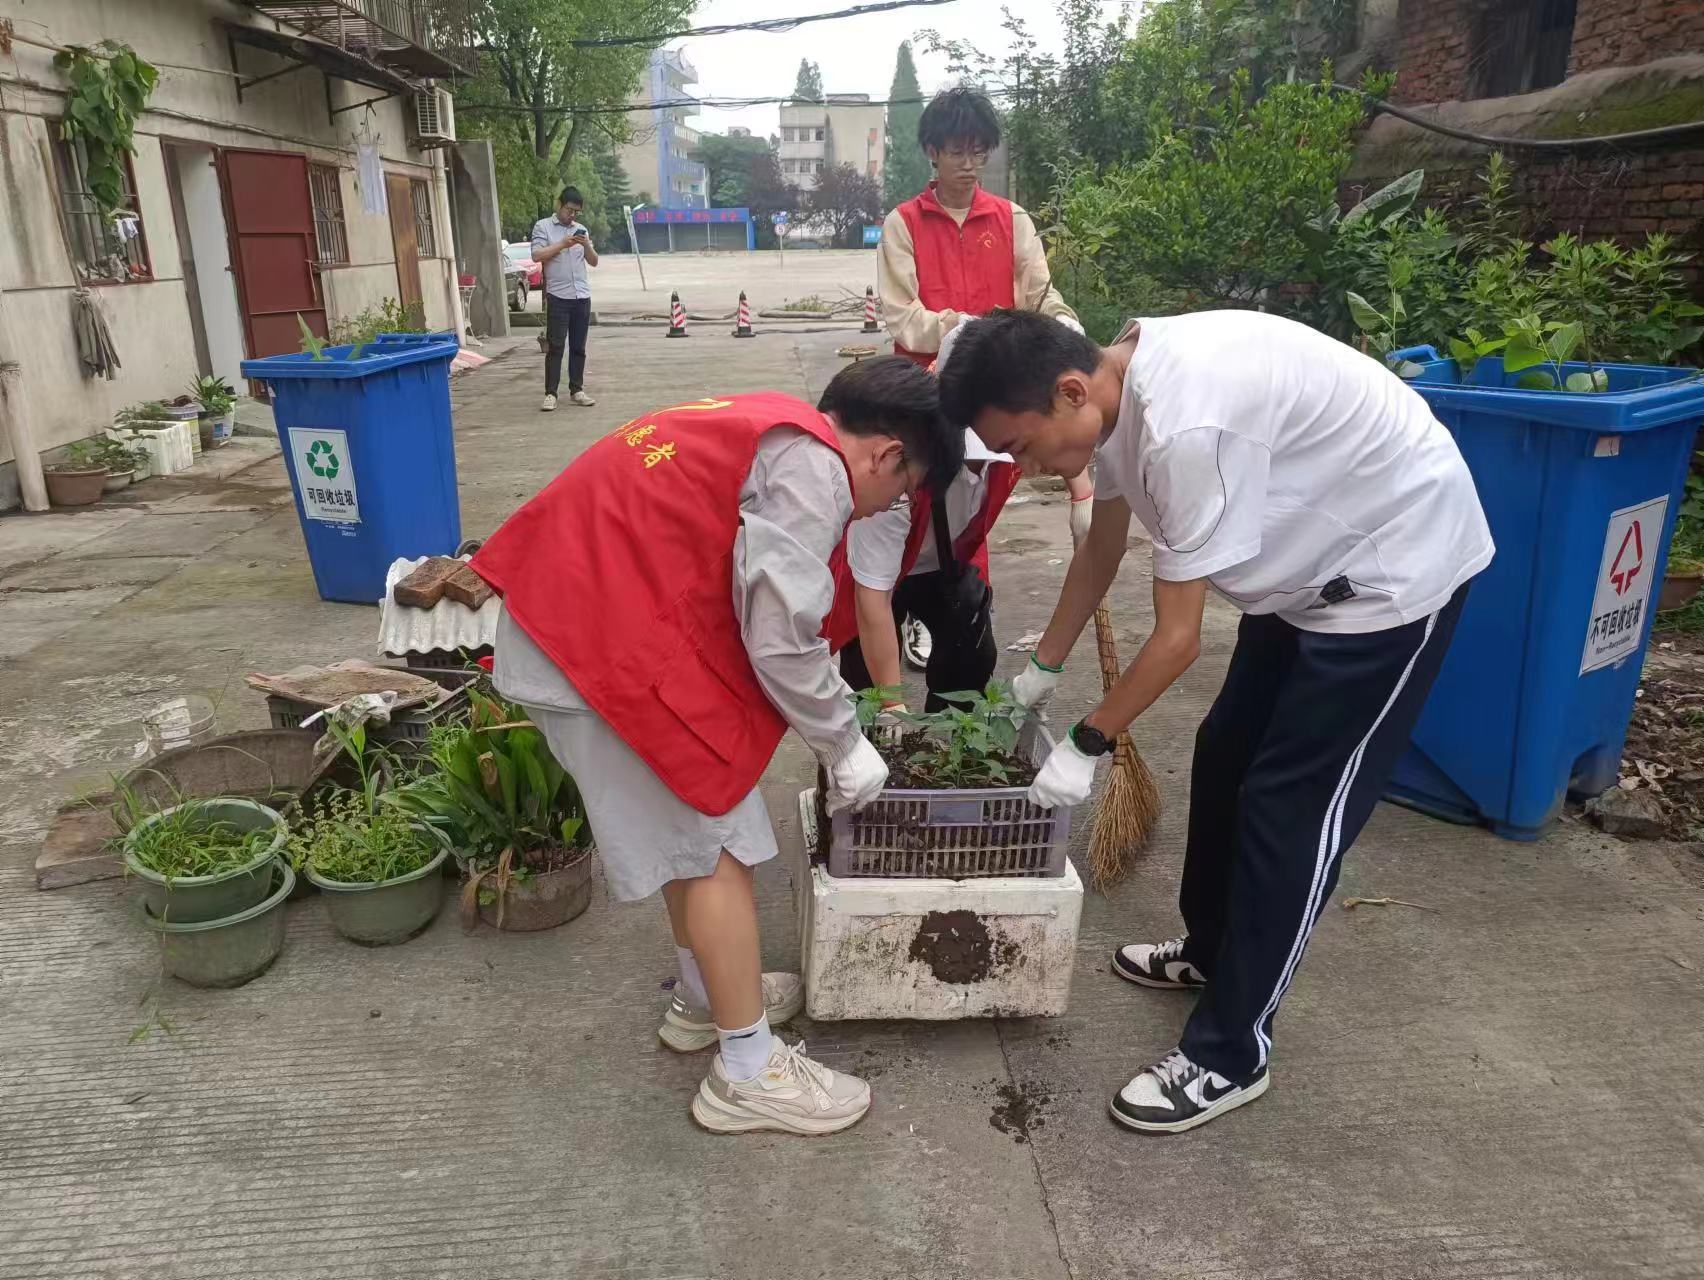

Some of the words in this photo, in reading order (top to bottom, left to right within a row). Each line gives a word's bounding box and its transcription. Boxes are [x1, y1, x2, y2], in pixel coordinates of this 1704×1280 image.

[612, 418, 677, 469] 愿者
[307, 487, 355, 506] 可回收垃圾
[1590, 599, 1643, 645] 不可回收垃圾
